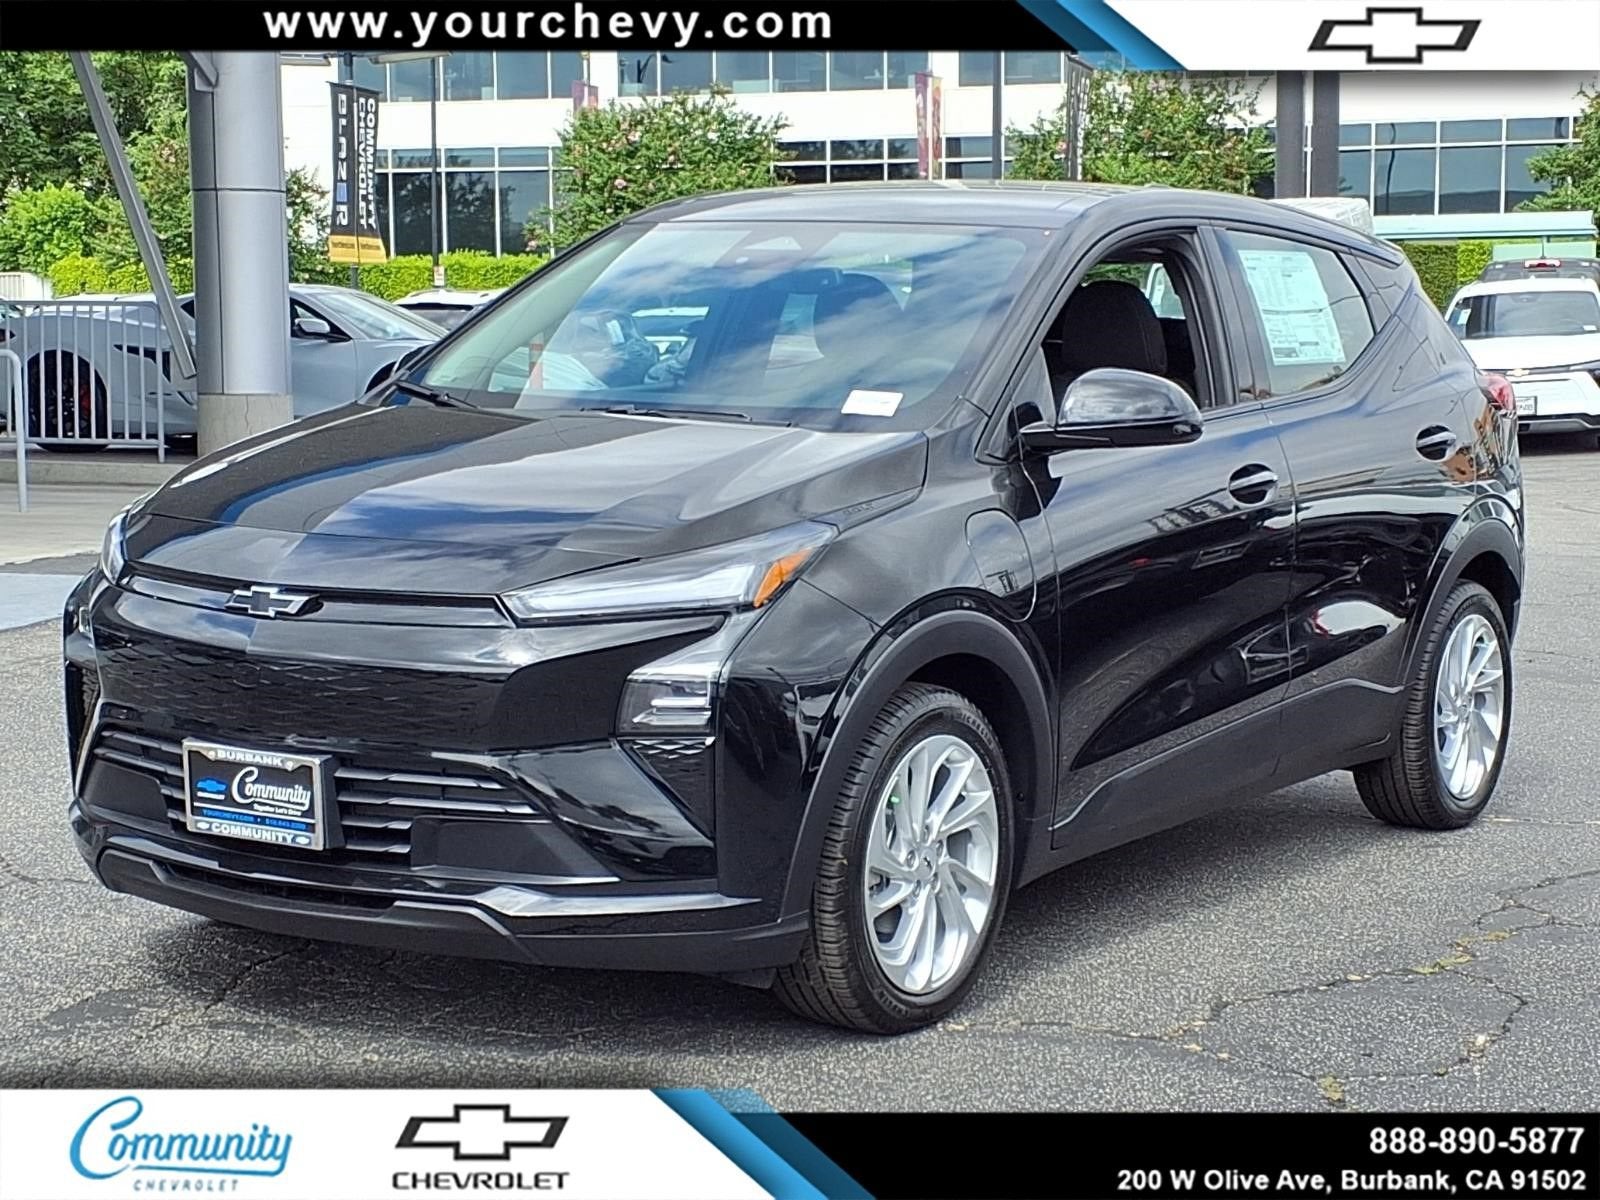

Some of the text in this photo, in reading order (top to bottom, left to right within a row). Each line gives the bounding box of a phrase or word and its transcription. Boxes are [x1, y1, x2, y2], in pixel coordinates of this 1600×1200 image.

[357, 97, 368, 230] CHEVROLET
[365, 98, 377, 230] COMMUNITY
[217, 750, 283, 767] BURBANK
[231, 766, 311, 811] Community
[211, 822, 294, 844] COMMUNITY
